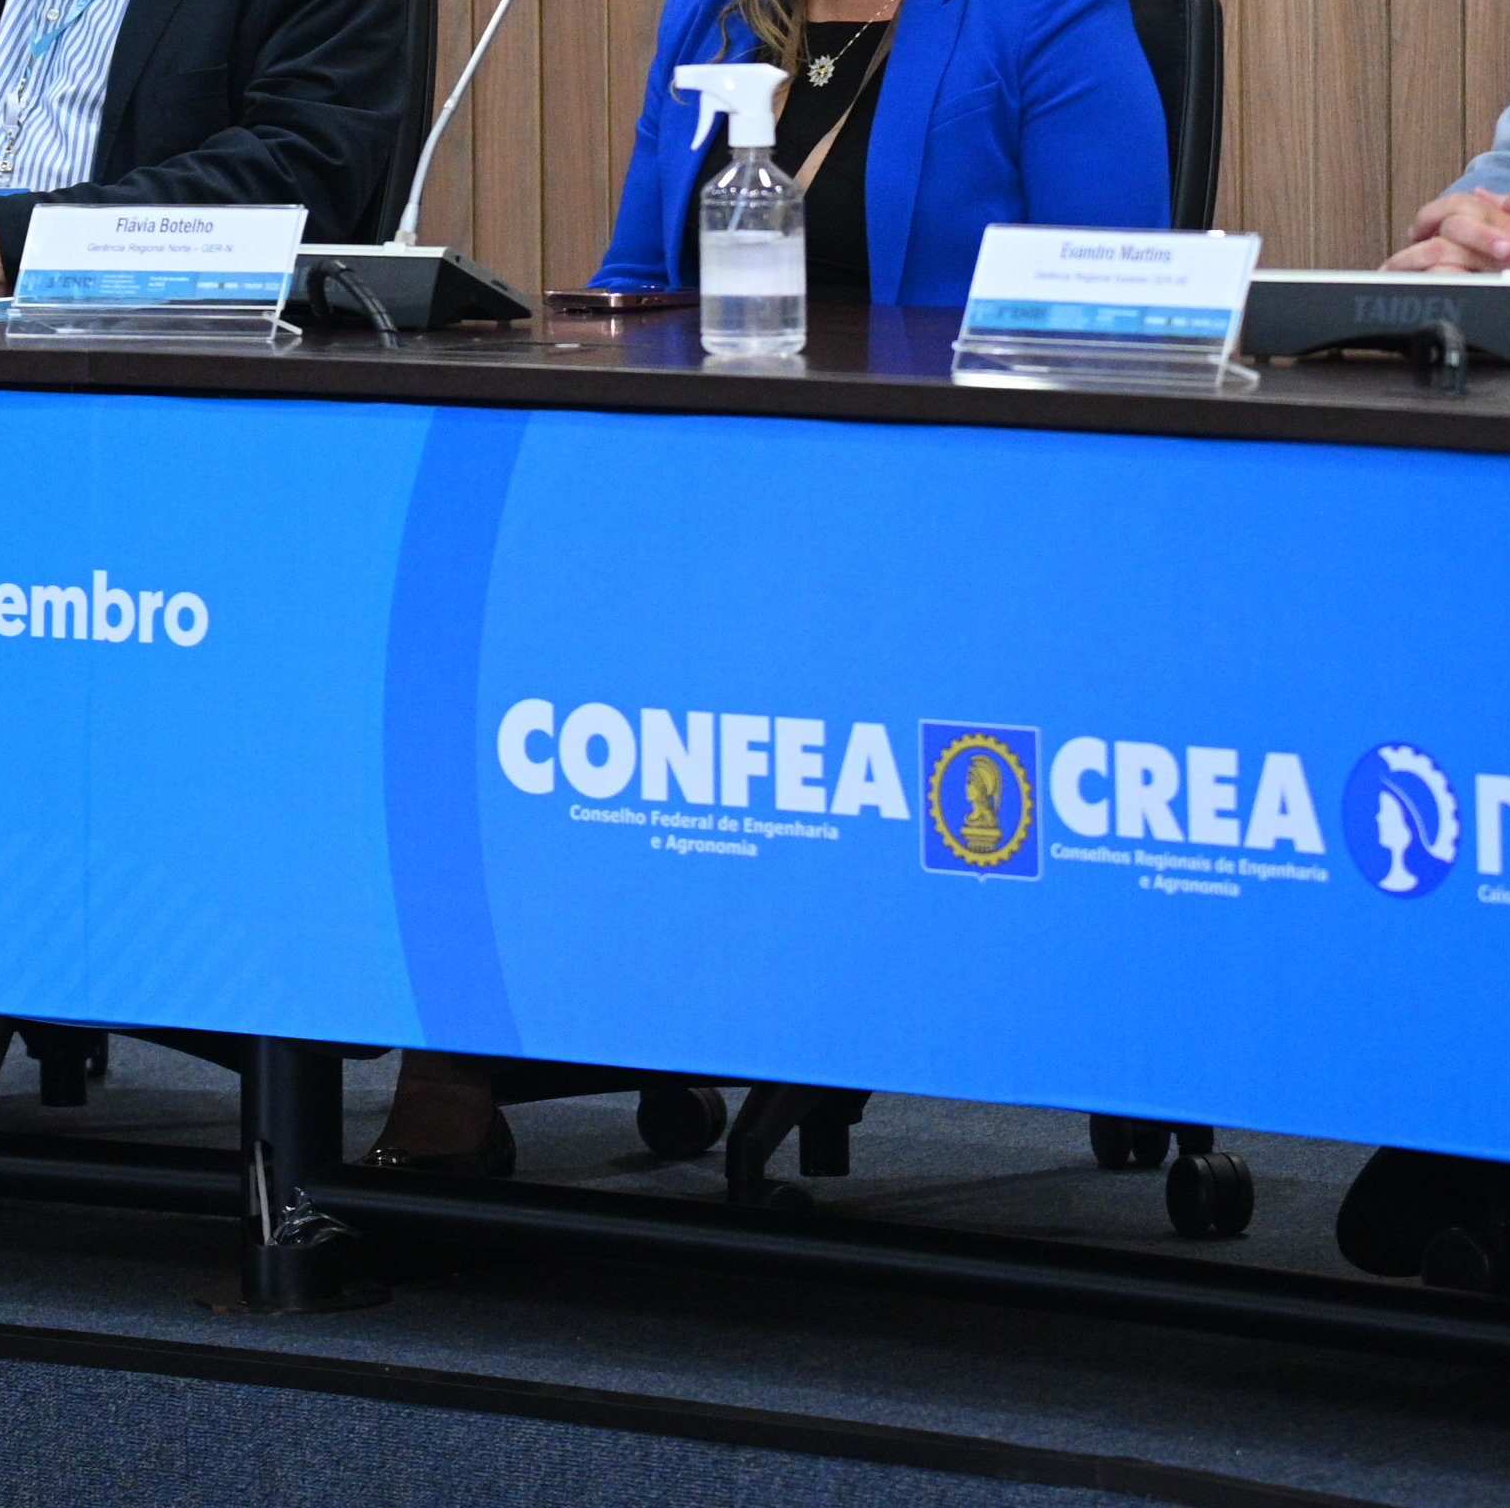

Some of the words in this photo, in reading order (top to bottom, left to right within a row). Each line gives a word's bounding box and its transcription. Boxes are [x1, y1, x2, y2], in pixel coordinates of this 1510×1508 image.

[115, 217, 156, 233] Flávia
[159, 217, 214, 234] Botelho
[1060, 242, 1115, 260] Evandro
[1118, 245, 1172, 262] Martins
[496, 698, 911, 820] CONFEA
[1049, 736, 1327, 855] CREA
[569, 804, 647, 825] Conselho
[650, 810, 714, 830] Federal
[717, 815, 739, 832] de
[743, 817, 839, 840] Engenharia
[650, 836, 662, 850] e
[665, 834, 758, 857] Agronomia
[1050, 842, 1132, 865] Conselhos
[1134, 848, 1212, 872] Regionais
[1214, 856, 1236, 874] de
[1238, 858, 1329, 882] Engenharia
[1138, 875, 1151, 889] e
[1153, 873, 1240, 897] Agronomia
